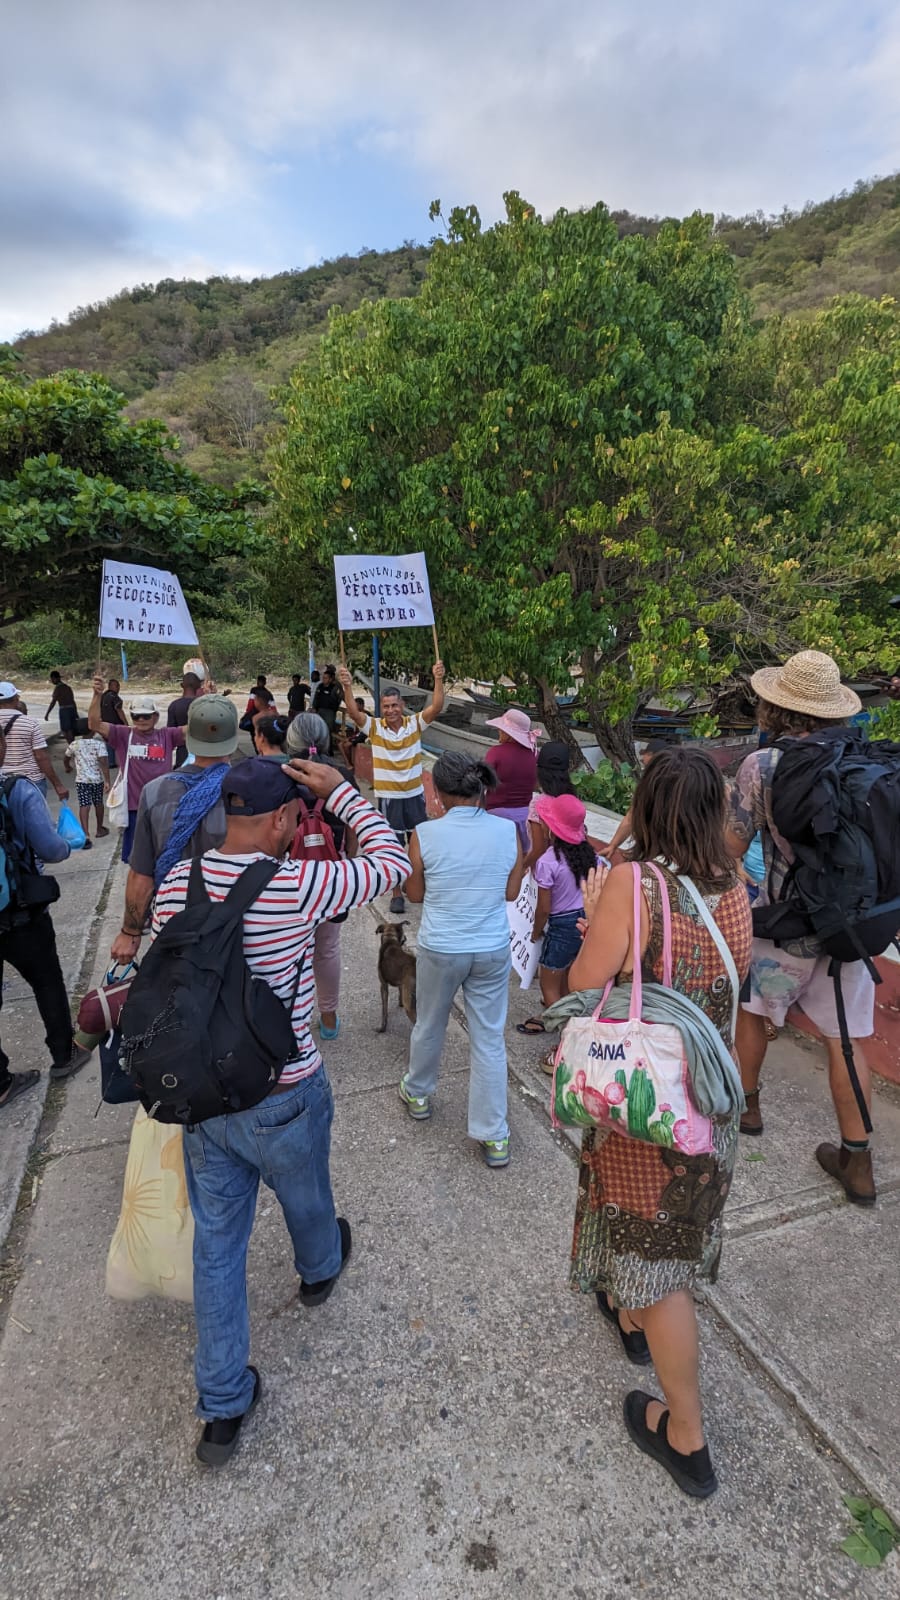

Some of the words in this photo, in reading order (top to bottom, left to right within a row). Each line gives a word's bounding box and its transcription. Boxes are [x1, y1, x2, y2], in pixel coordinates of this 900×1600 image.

[107, 585, 177, 607] CECOCESOLA
[345, 581, 424, 597] CECOCESOLA
[352, 607, 416, 622] MACURO
[115, 618, 173, 636] MACURO
